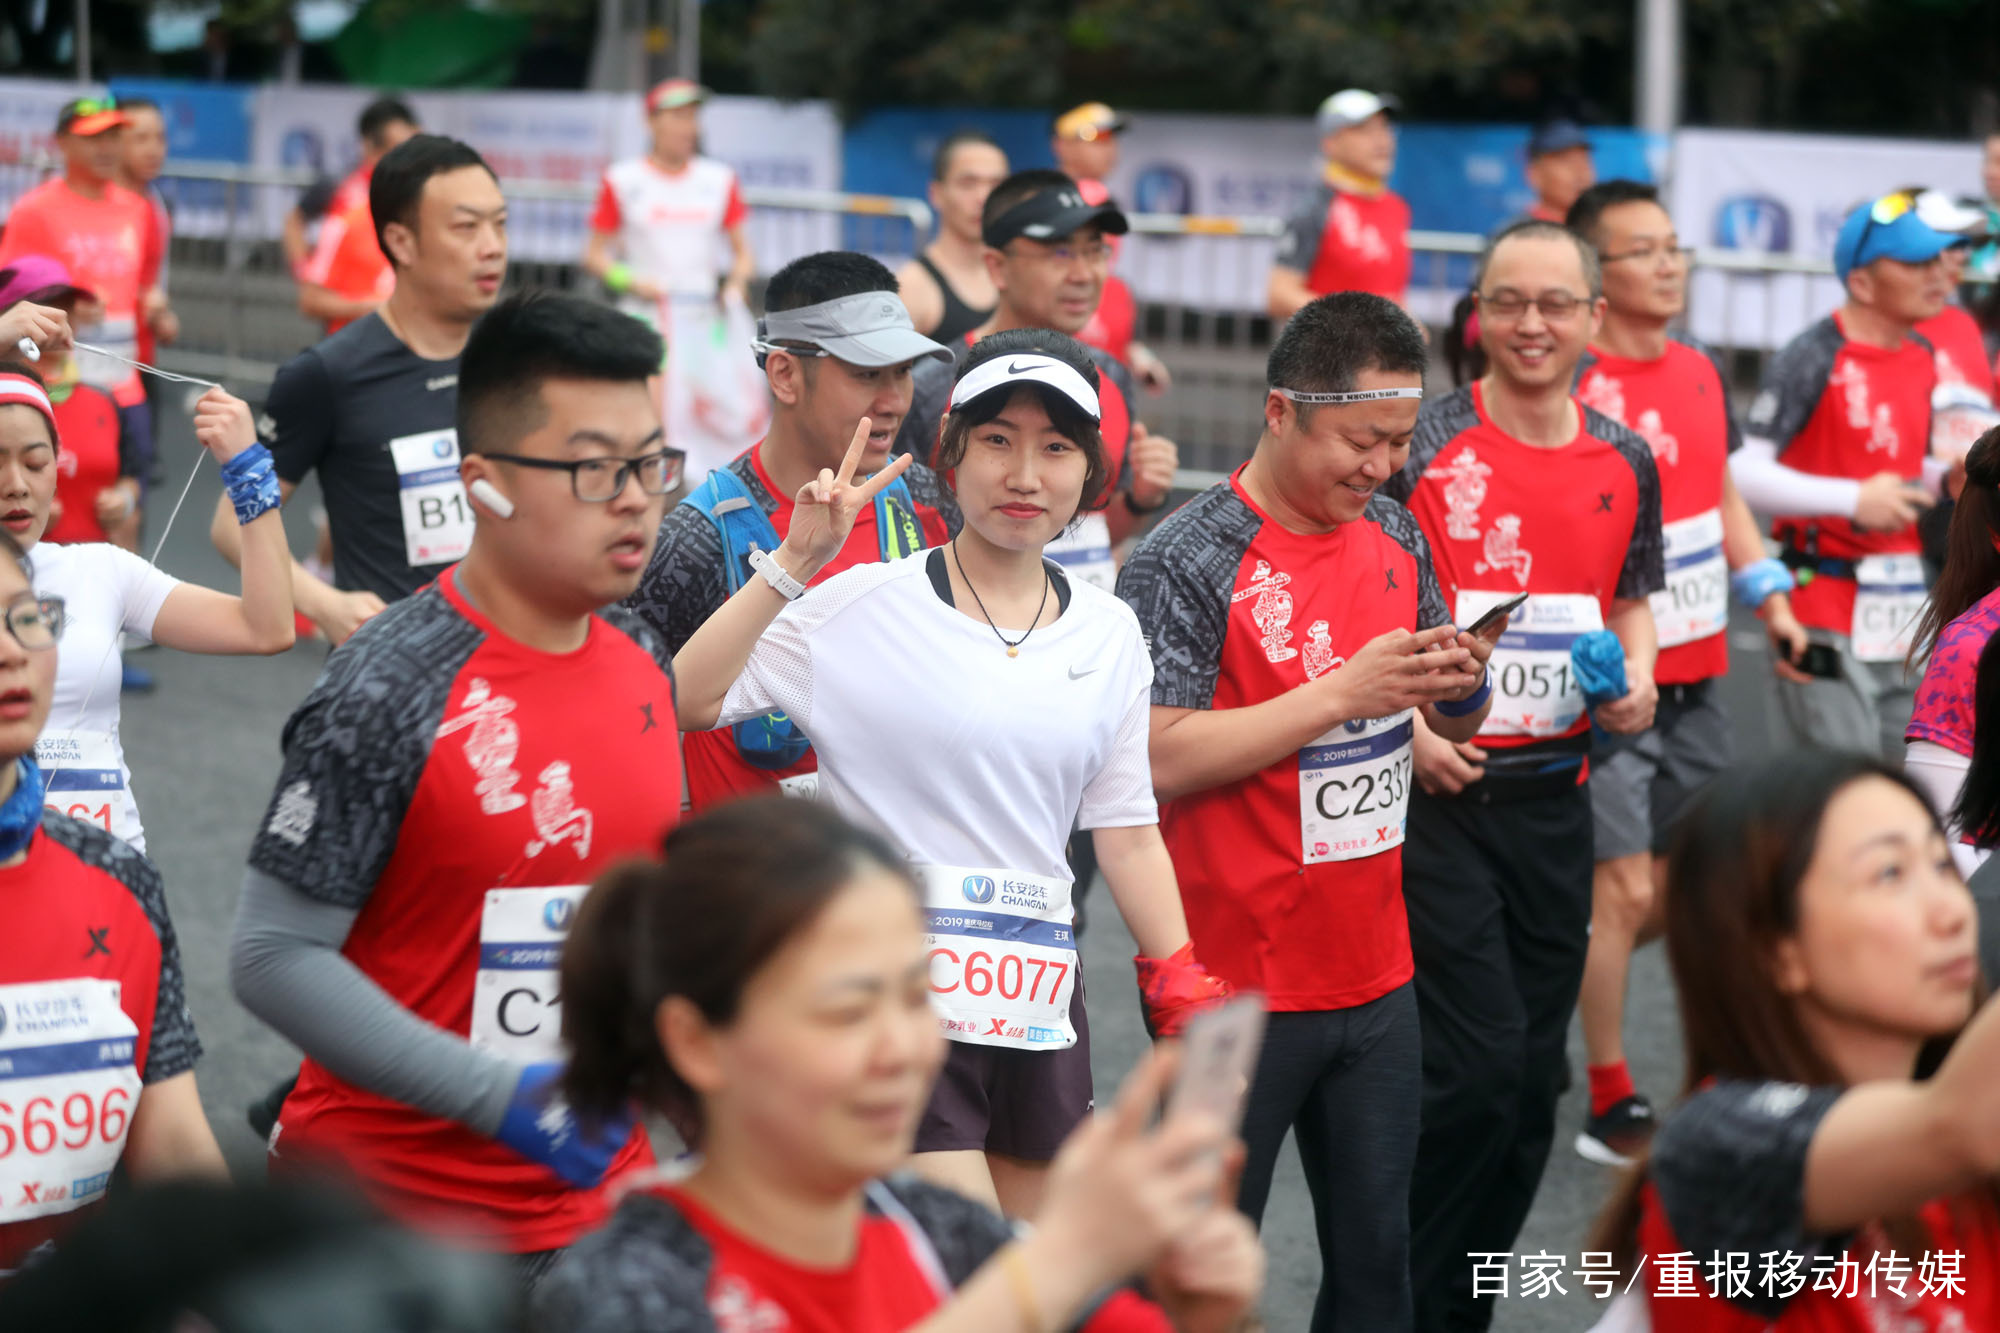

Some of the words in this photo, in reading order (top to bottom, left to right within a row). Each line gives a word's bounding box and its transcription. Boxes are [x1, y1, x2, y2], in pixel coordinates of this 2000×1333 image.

[419, 494, 475, 529] B1
[1488, 662, 1581, 699] 051
[37, 751, 81, 760] HANGAN
[1323, 751, 1348, 762] 2019
[1315, 754, 1410, 820] C2337
[1003, 880, 1048, 898] 长安汽车
[1001, 895, 1048, 911] CHANGAN
[935, 916, 962, 927] 2019
[926, 948, 1068, 1005] C6077
[497, 987, 562, 1037] C
